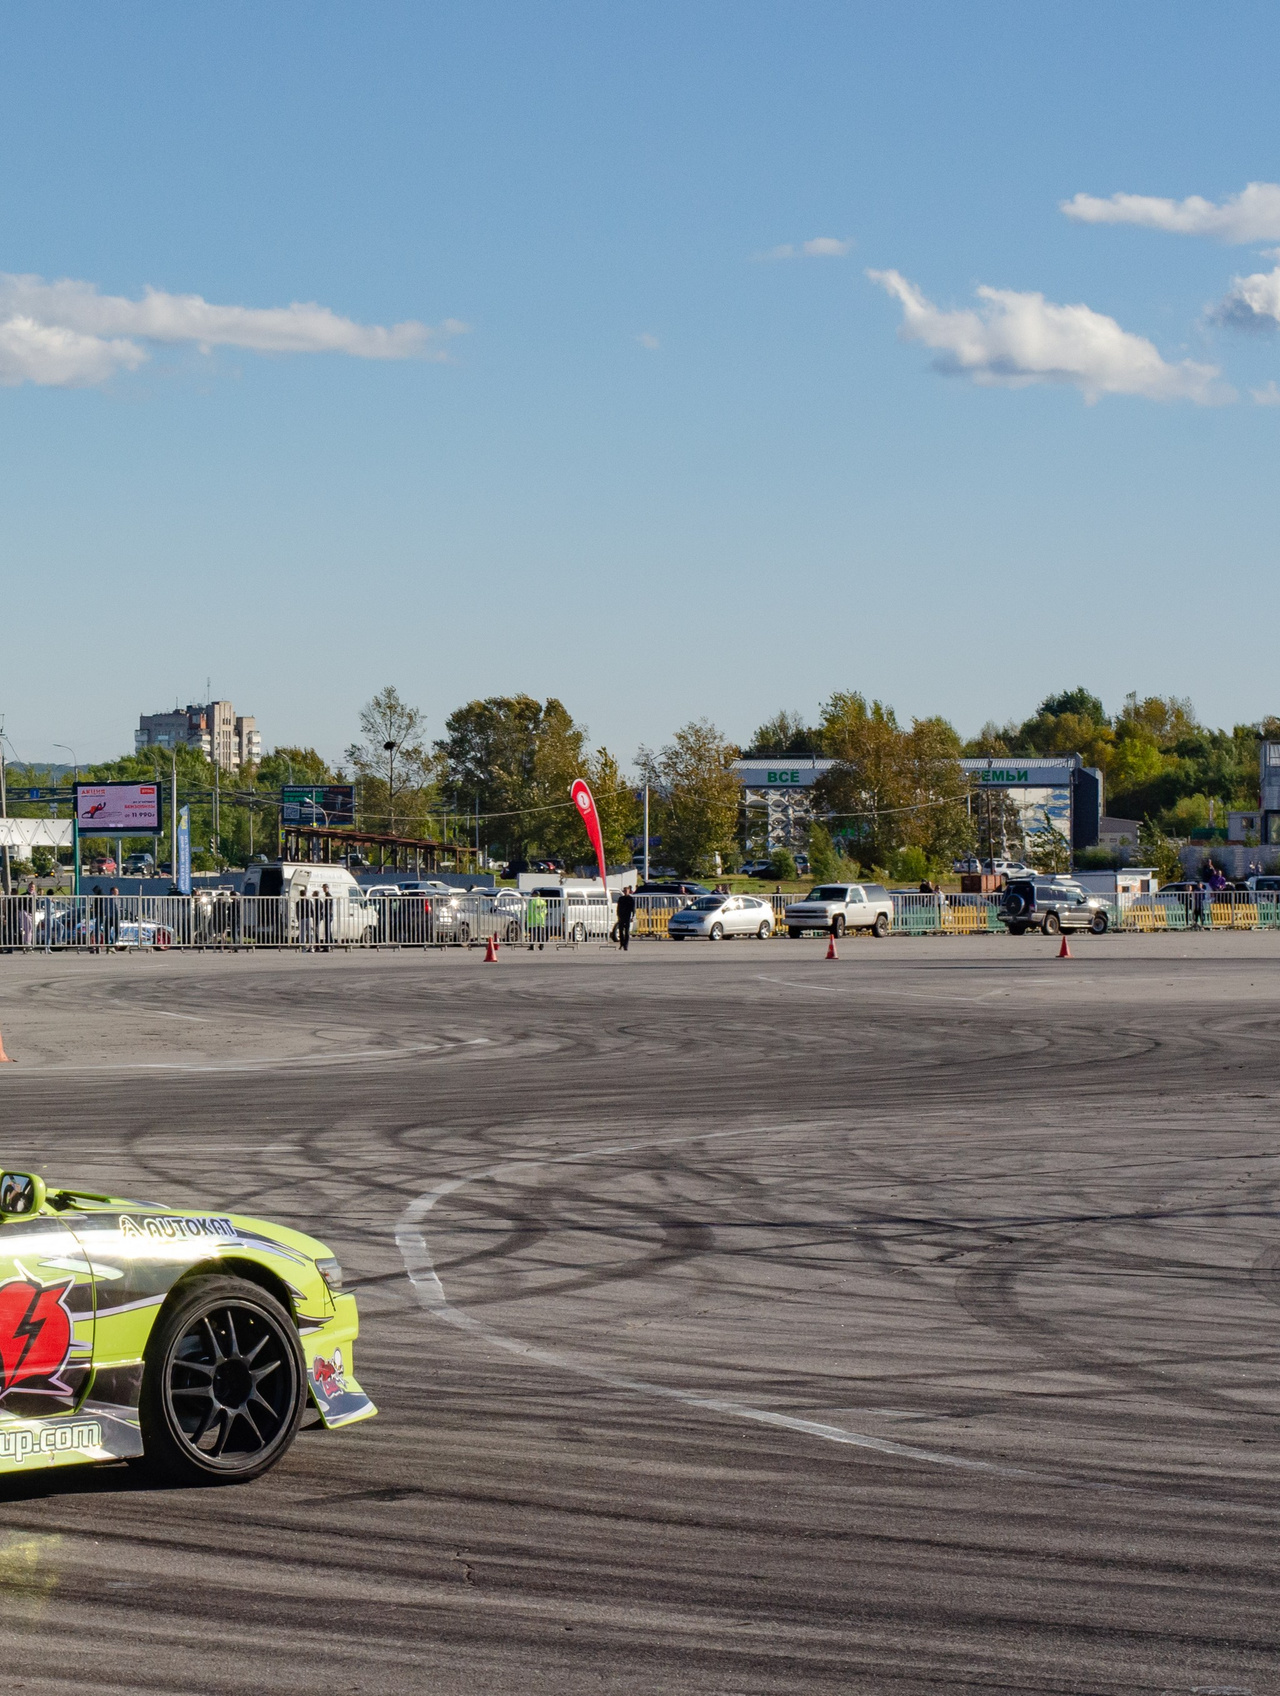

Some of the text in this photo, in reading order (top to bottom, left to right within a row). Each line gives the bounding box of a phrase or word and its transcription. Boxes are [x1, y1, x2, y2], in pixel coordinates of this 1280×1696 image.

[767, 769, 800, 783] ВСЁ
[972, 770, 1028, 782] ЕМЬИ
[144, 1217, 237, 1238] AUTOKAT
